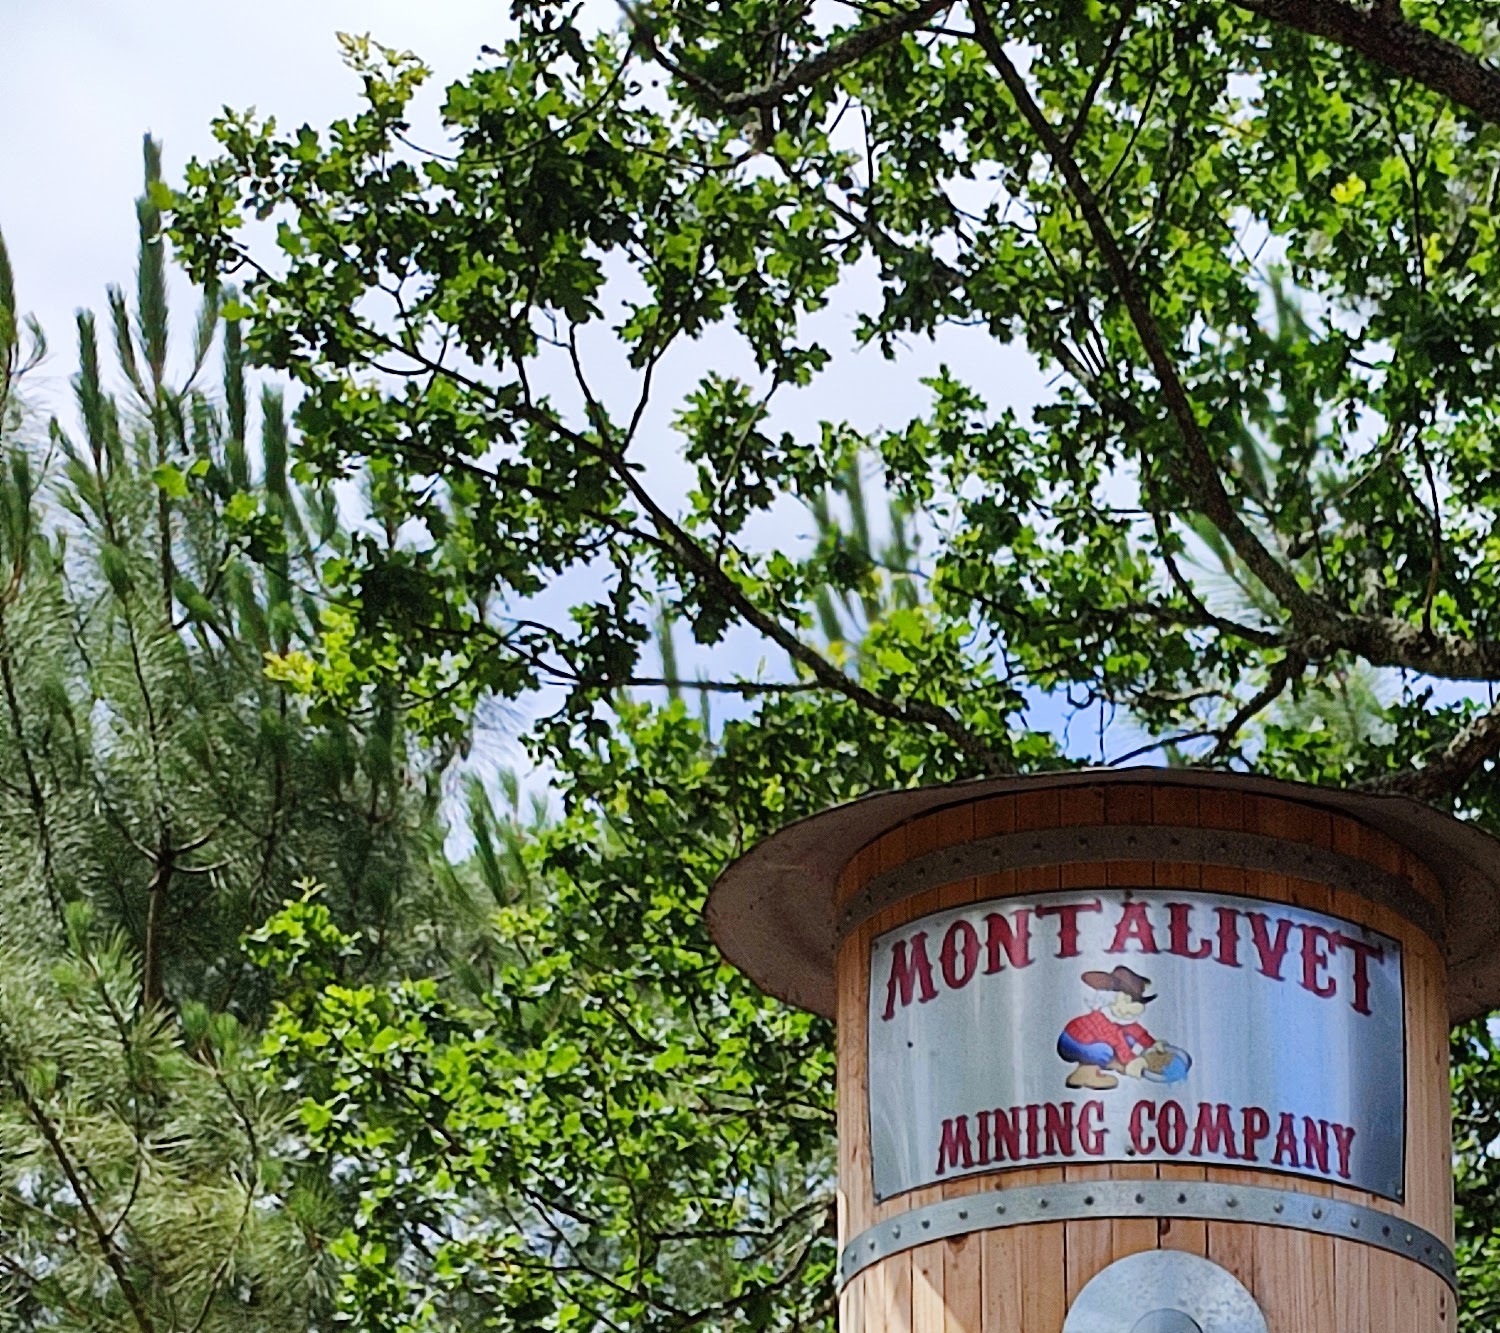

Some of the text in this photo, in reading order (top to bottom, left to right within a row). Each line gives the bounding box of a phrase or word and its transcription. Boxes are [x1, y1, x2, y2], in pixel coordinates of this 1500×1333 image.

[882, 900, 1385, 1021] MONTALIVET
[935, 1100, 1358, 1180] MINING COMPANY
